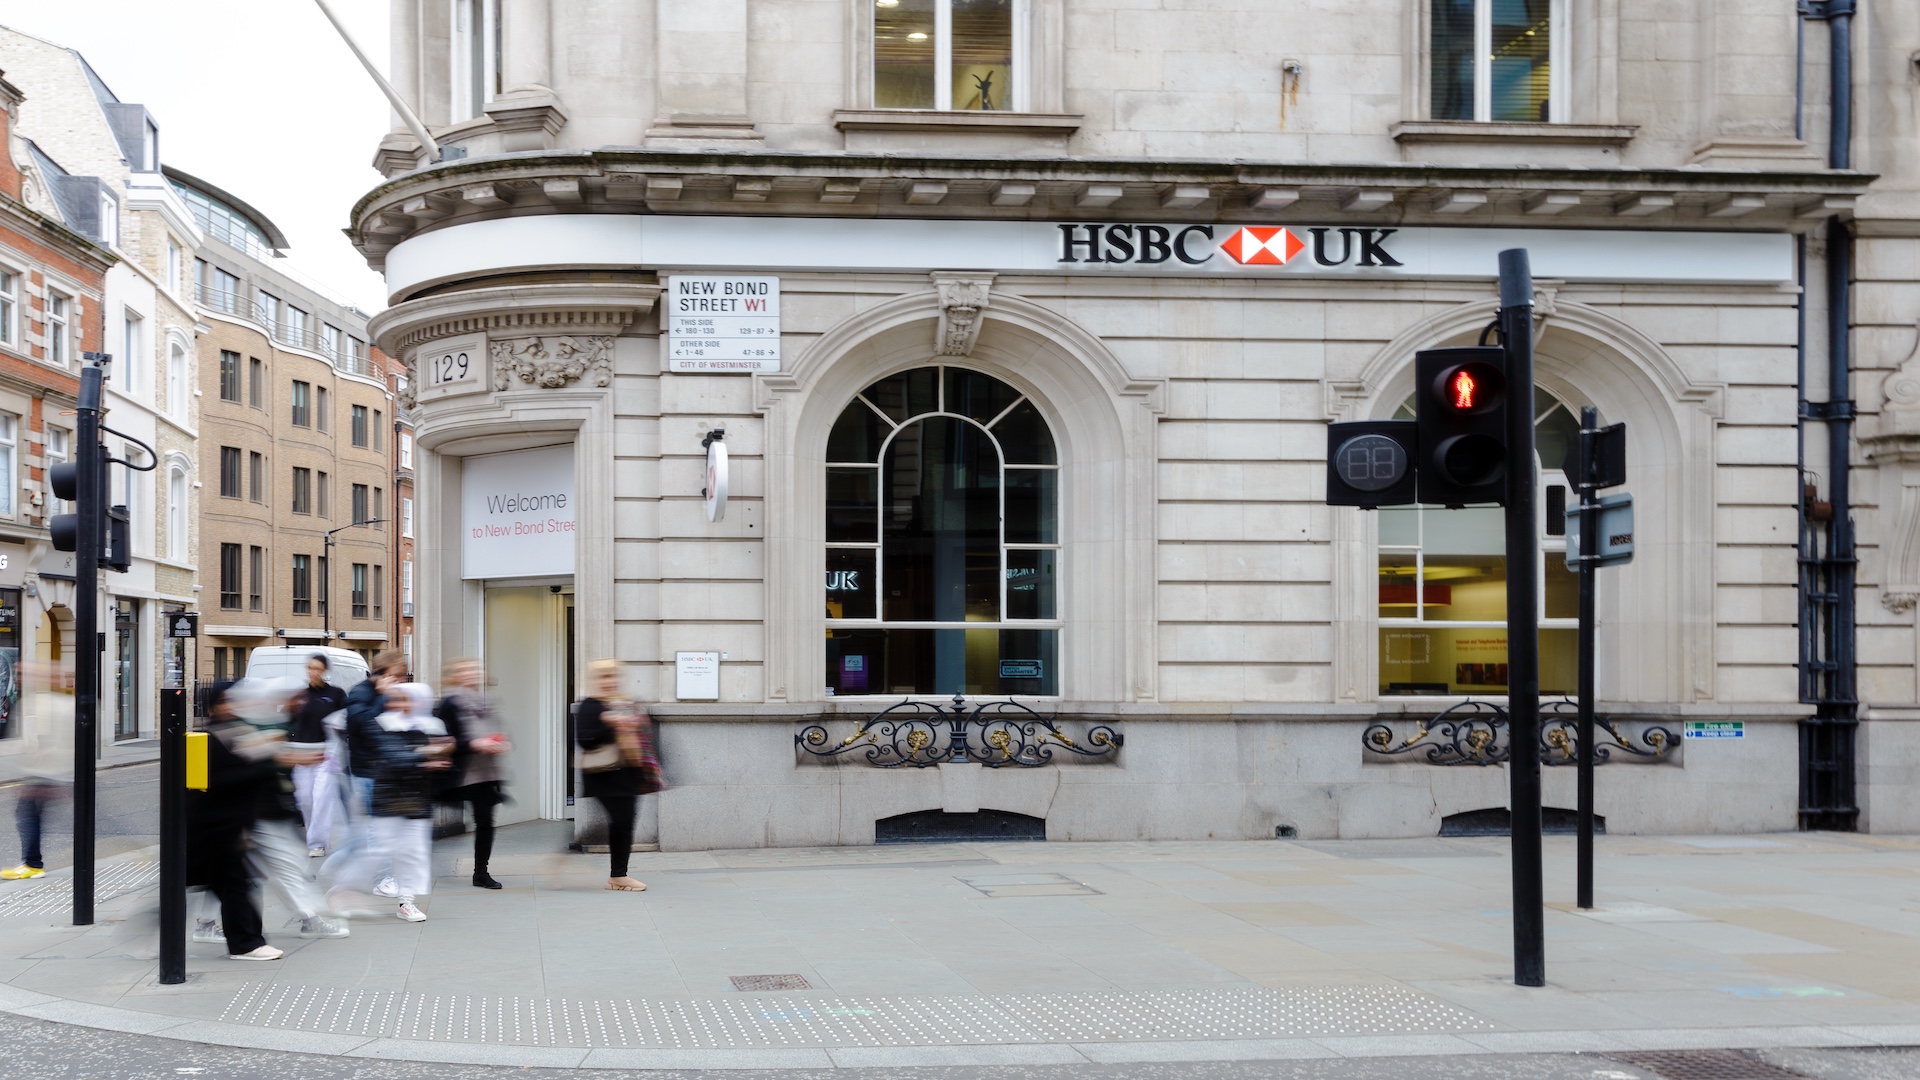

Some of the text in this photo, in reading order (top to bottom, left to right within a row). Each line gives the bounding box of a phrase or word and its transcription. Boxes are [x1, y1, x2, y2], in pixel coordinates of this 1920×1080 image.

[1057, 224, 1404, 267] HSBC UK
[680, 281, 768, 295] NEW BOND
[680, 298, 766, 312] STREET W1
[680, 340, 720, 348] OTHER SIDE
[435, 352, 469, 384] 129
[680, 361, 762, 369] CITY OF WESTMINSTER
[487, 493, 567, 514] Welcome
[472, 528, 483, 539] to
[485, 524, 511, 538] New
[514, 520, 544, 535] Bond
[825, 571, 859, 590] UK
